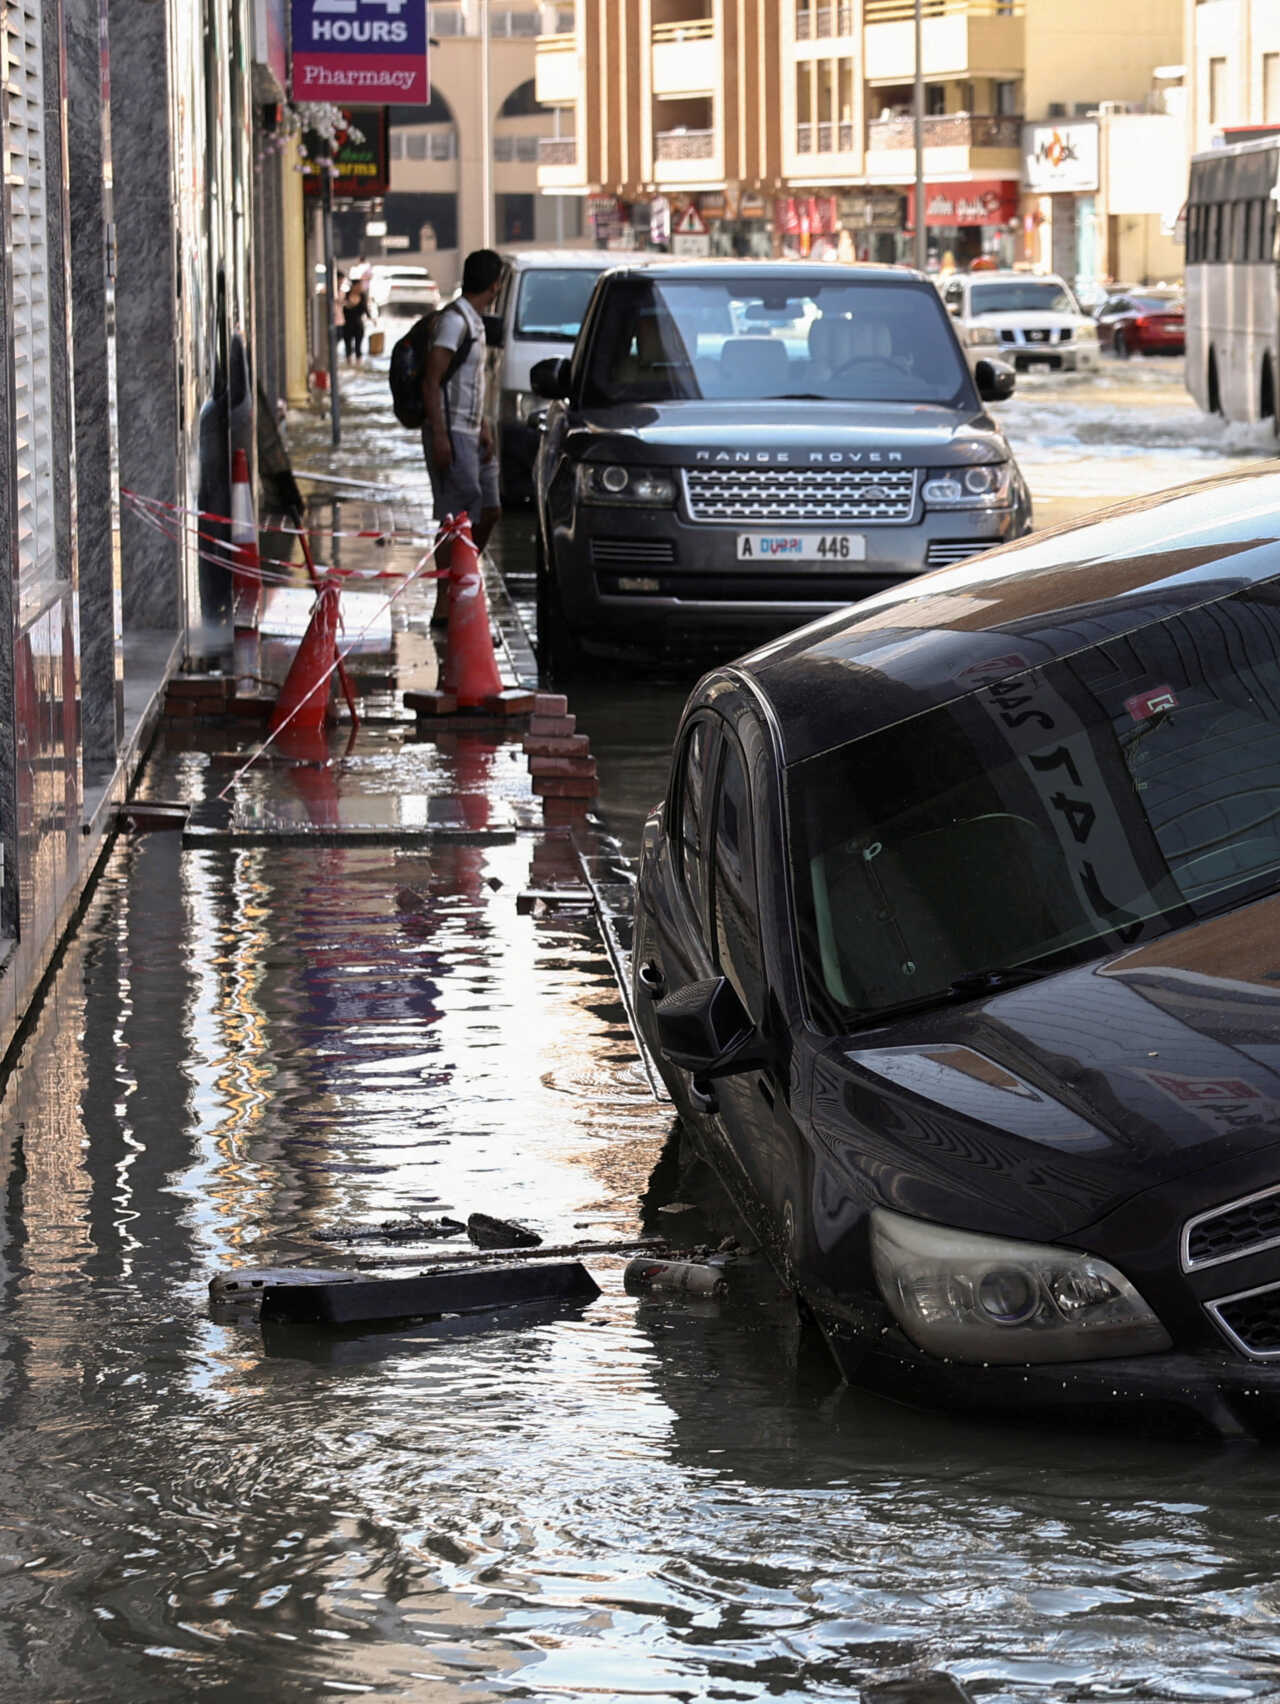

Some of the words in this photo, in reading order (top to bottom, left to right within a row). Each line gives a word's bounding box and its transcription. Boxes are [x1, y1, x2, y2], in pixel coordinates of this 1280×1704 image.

[312, 20, 408, 41] HOURS
[303, 65, 416, 90] Pharmacy
[696, 451, 789, 462] RANGE
[810, 452, 902, 463] ROVER
[742, 536, 753, 557] A
[817, 536, 849, 558] 446
